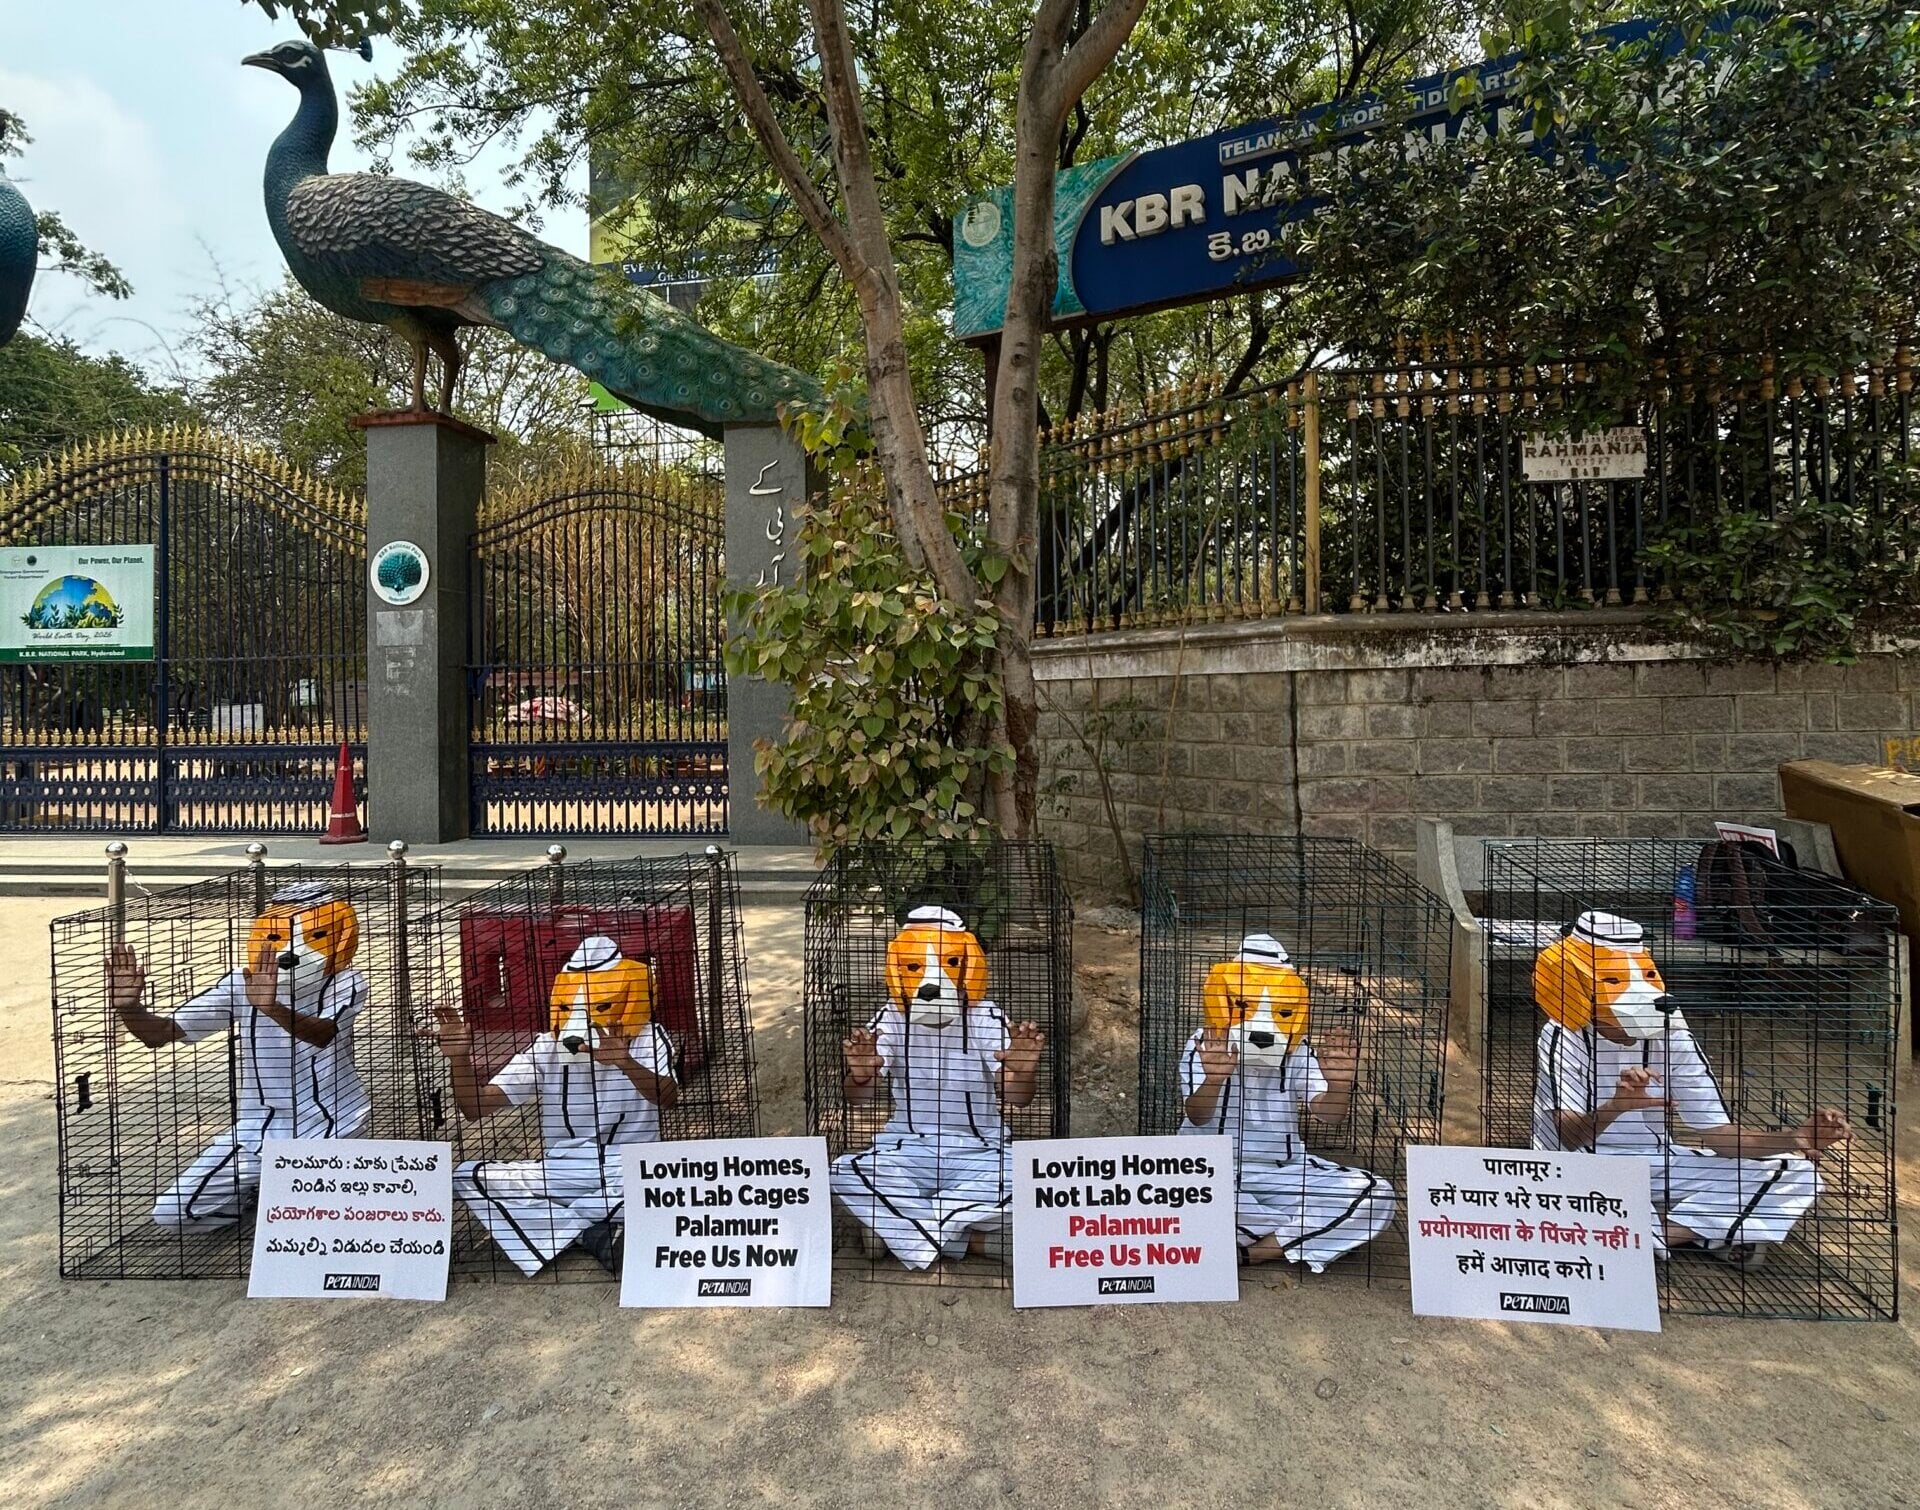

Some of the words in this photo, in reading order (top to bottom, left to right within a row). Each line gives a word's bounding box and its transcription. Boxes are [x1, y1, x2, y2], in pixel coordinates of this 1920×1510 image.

[1100, 184, 1206, 246] KBR
[1524, 442, 1646, 459] RAHMANIA
[112, 556, 122, 564] Our
[275, 1155, 343, 1170] పాలమూరు
[353, 1156, 387, 1170] మాకు
[391, 1155, 438, 1173] ప్రేమతో
[640, 1157, 718, 1181] Loving
[723, 1156, 810, 1179] Homes,
[1032, 1156, 1115, 1180] Loving
[1122, 1155, 1214, 1177] Homes,
[1483, 1158, 1550, 1182] पालामूर
[292, 1179, 336, 1193] నిండిన
[341, 1182, 368, 1196] ఇల్లు
[373, 1180, 417, 1196] కావాలి,
[644, 1188, 685, 1208] Not
[691, 1185, 733, 1206] Lab
[738, 1185, 809, 1209] Cages
[1035, 1187, 1080, 1208] Not
[1086, 1184, 1131, 1206] Lab
[1137, 1183, 1212, 1208] Cages
[1428, 1183, 1457, 1207] हमें
[1461, 1189, 1499, 1208] प्यार
[1505, 1186, 1532, 1209] भरे
[1536, 1193, 1562, 1211] घर
[1567, 1191, 1628, 1218] चाहिए,
[267, 1206, 340, 1223] ప్రయోగశాల
[344, 1207, 408, 1221] పంజరాలు
[412, 1208, 445, 1222] కాదు.
[676, 1215, 778, 1237] Palamur:
[1069, 1214, 1180, 1237] Palamur:
[1419, 1215, 1510, 1241] प्रयोगशाला
[1515, 1218, 1534, 1242] के
[1539, 1221, 1588, 1246] पिंजरे
[1592, 1226, 1629, 1250] नहीं
[267, 1237, 327, 1255] మమ్మల్ని
[333, 1239, 386, 1253] విడుదల
[390, 1239, 445, 1255] చేయండి
[655, 1246, 706, 1268] Free
[712, 1245, 740, 1267] Us
[746, 1245, 798, 1267] Now
[1049, 1246, 1104, 1268] Free
[1110, 1244, 1141, 1266] Us
[1147, 1243, 1201, 1265] Now
[1456, 1250, 1485, 1275] हमें
[1490, 1257, 1549, 1279] आज़ाद
[1555, 1256, 1592, 1280] करो
